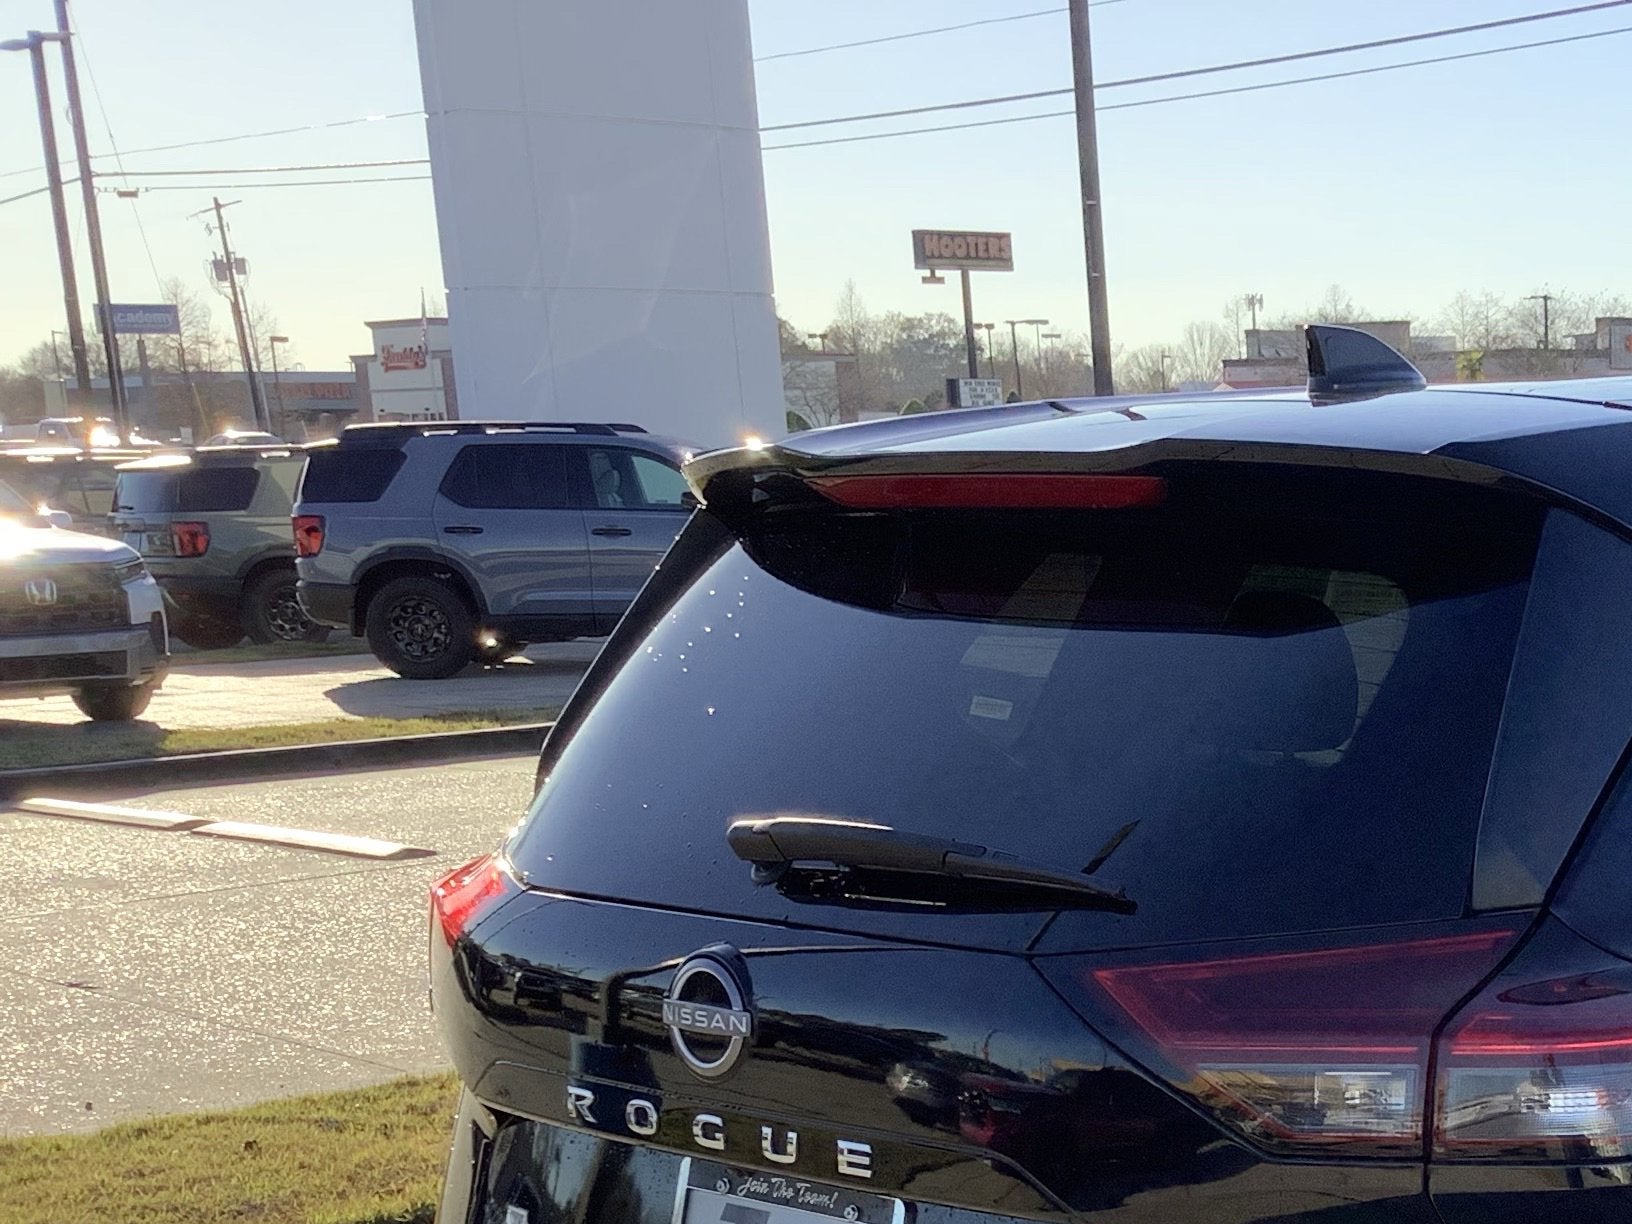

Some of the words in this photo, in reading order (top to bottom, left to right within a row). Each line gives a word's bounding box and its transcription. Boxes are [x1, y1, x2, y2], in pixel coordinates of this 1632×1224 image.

[923, 234, 1010, 259] HOOTERS
[663, 1003, 748, 1033] NISSAN
[566, 1085, 873, 1178] ROGUE
[737, 1176, 770, 1197] Join
[771, 1177, 795, 1199] The
[796, 1182, 839, 1209] Team!
